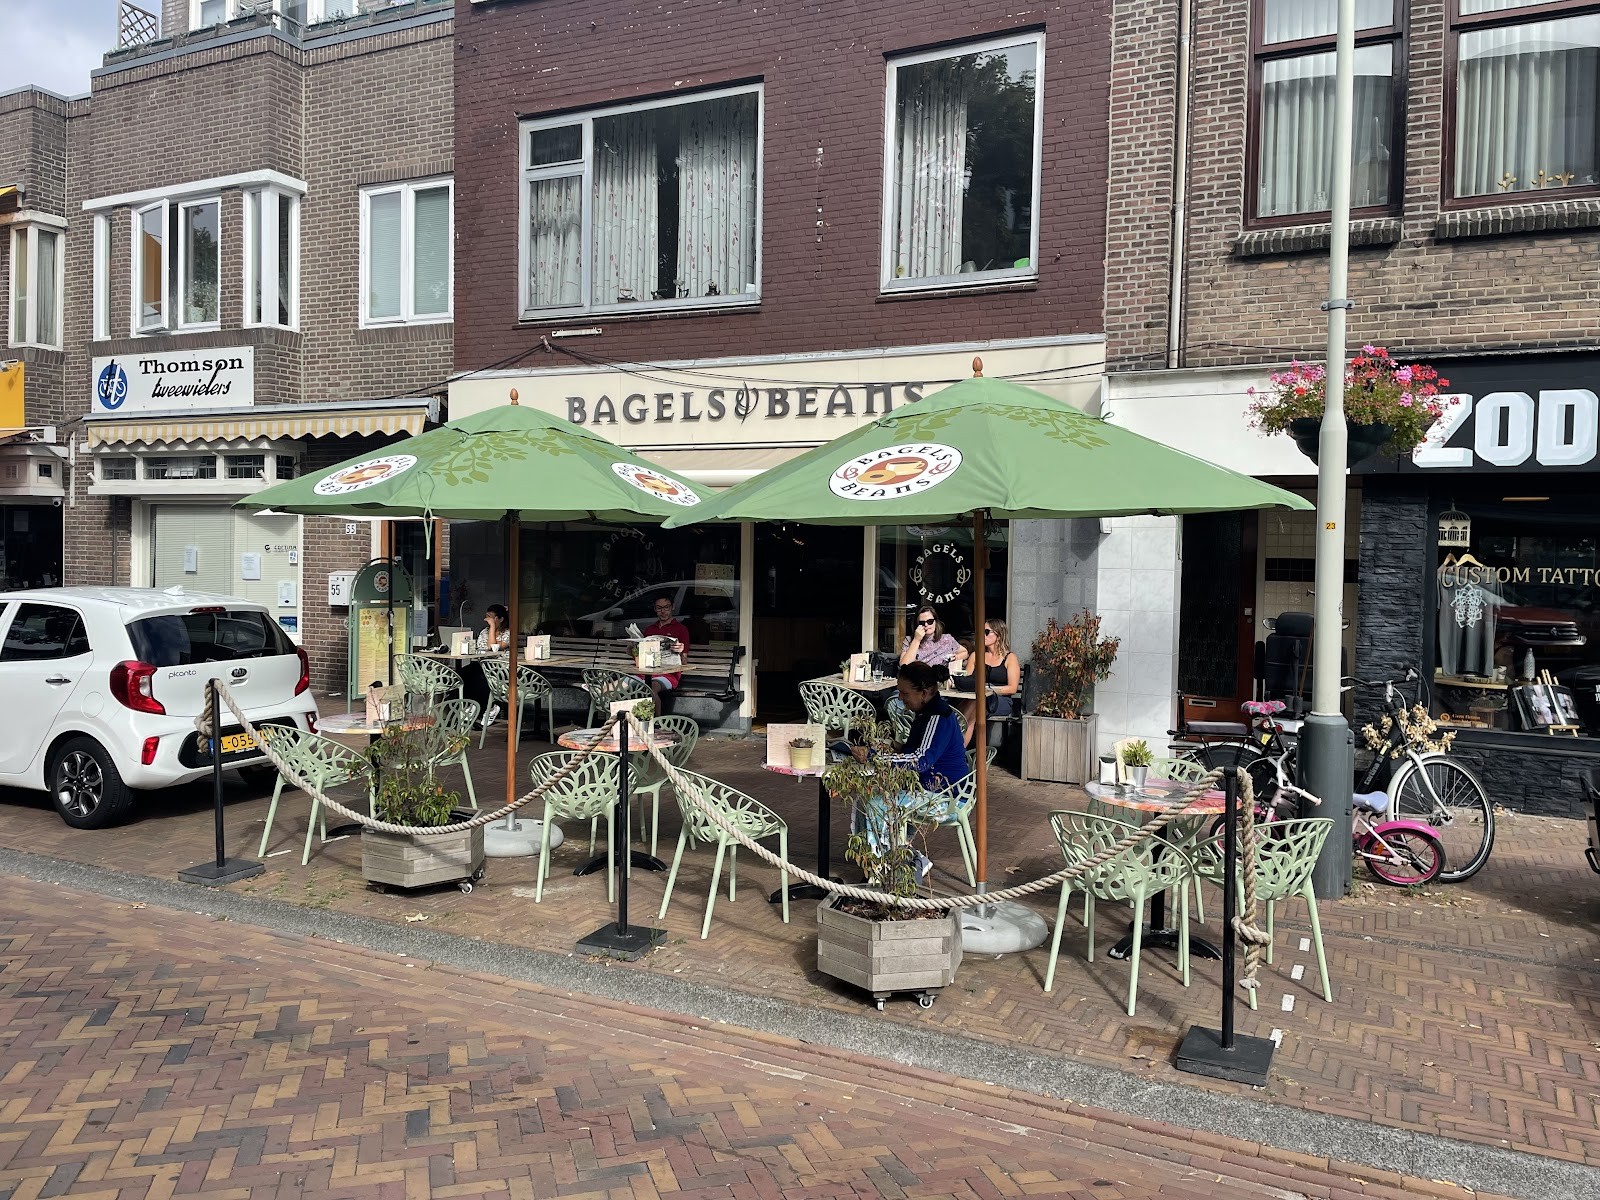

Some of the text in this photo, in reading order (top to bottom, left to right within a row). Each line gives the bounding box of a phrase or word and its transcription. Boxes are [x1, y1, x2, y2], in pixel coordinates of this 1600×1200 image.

[139, 357, 245, 375] Thomson
[151, 364, 232, 398] tweewielers
[565, 388, 727, 426] BAGELS
[1412, 388, 1599, 468] ZOD
[857, 446, 952, 465] BAGELS
[840, 478, 931, 498] BEANS
[346, 524, 355, 534] 55
[1326, 522, 1336, 530] 23
[916, 544, 964, 565] BAGELS
[1441, 566, 1531, 588] CUSTOM
[330, 584, 341, 596] 55
[918, 586, 961, 604] BEANS
